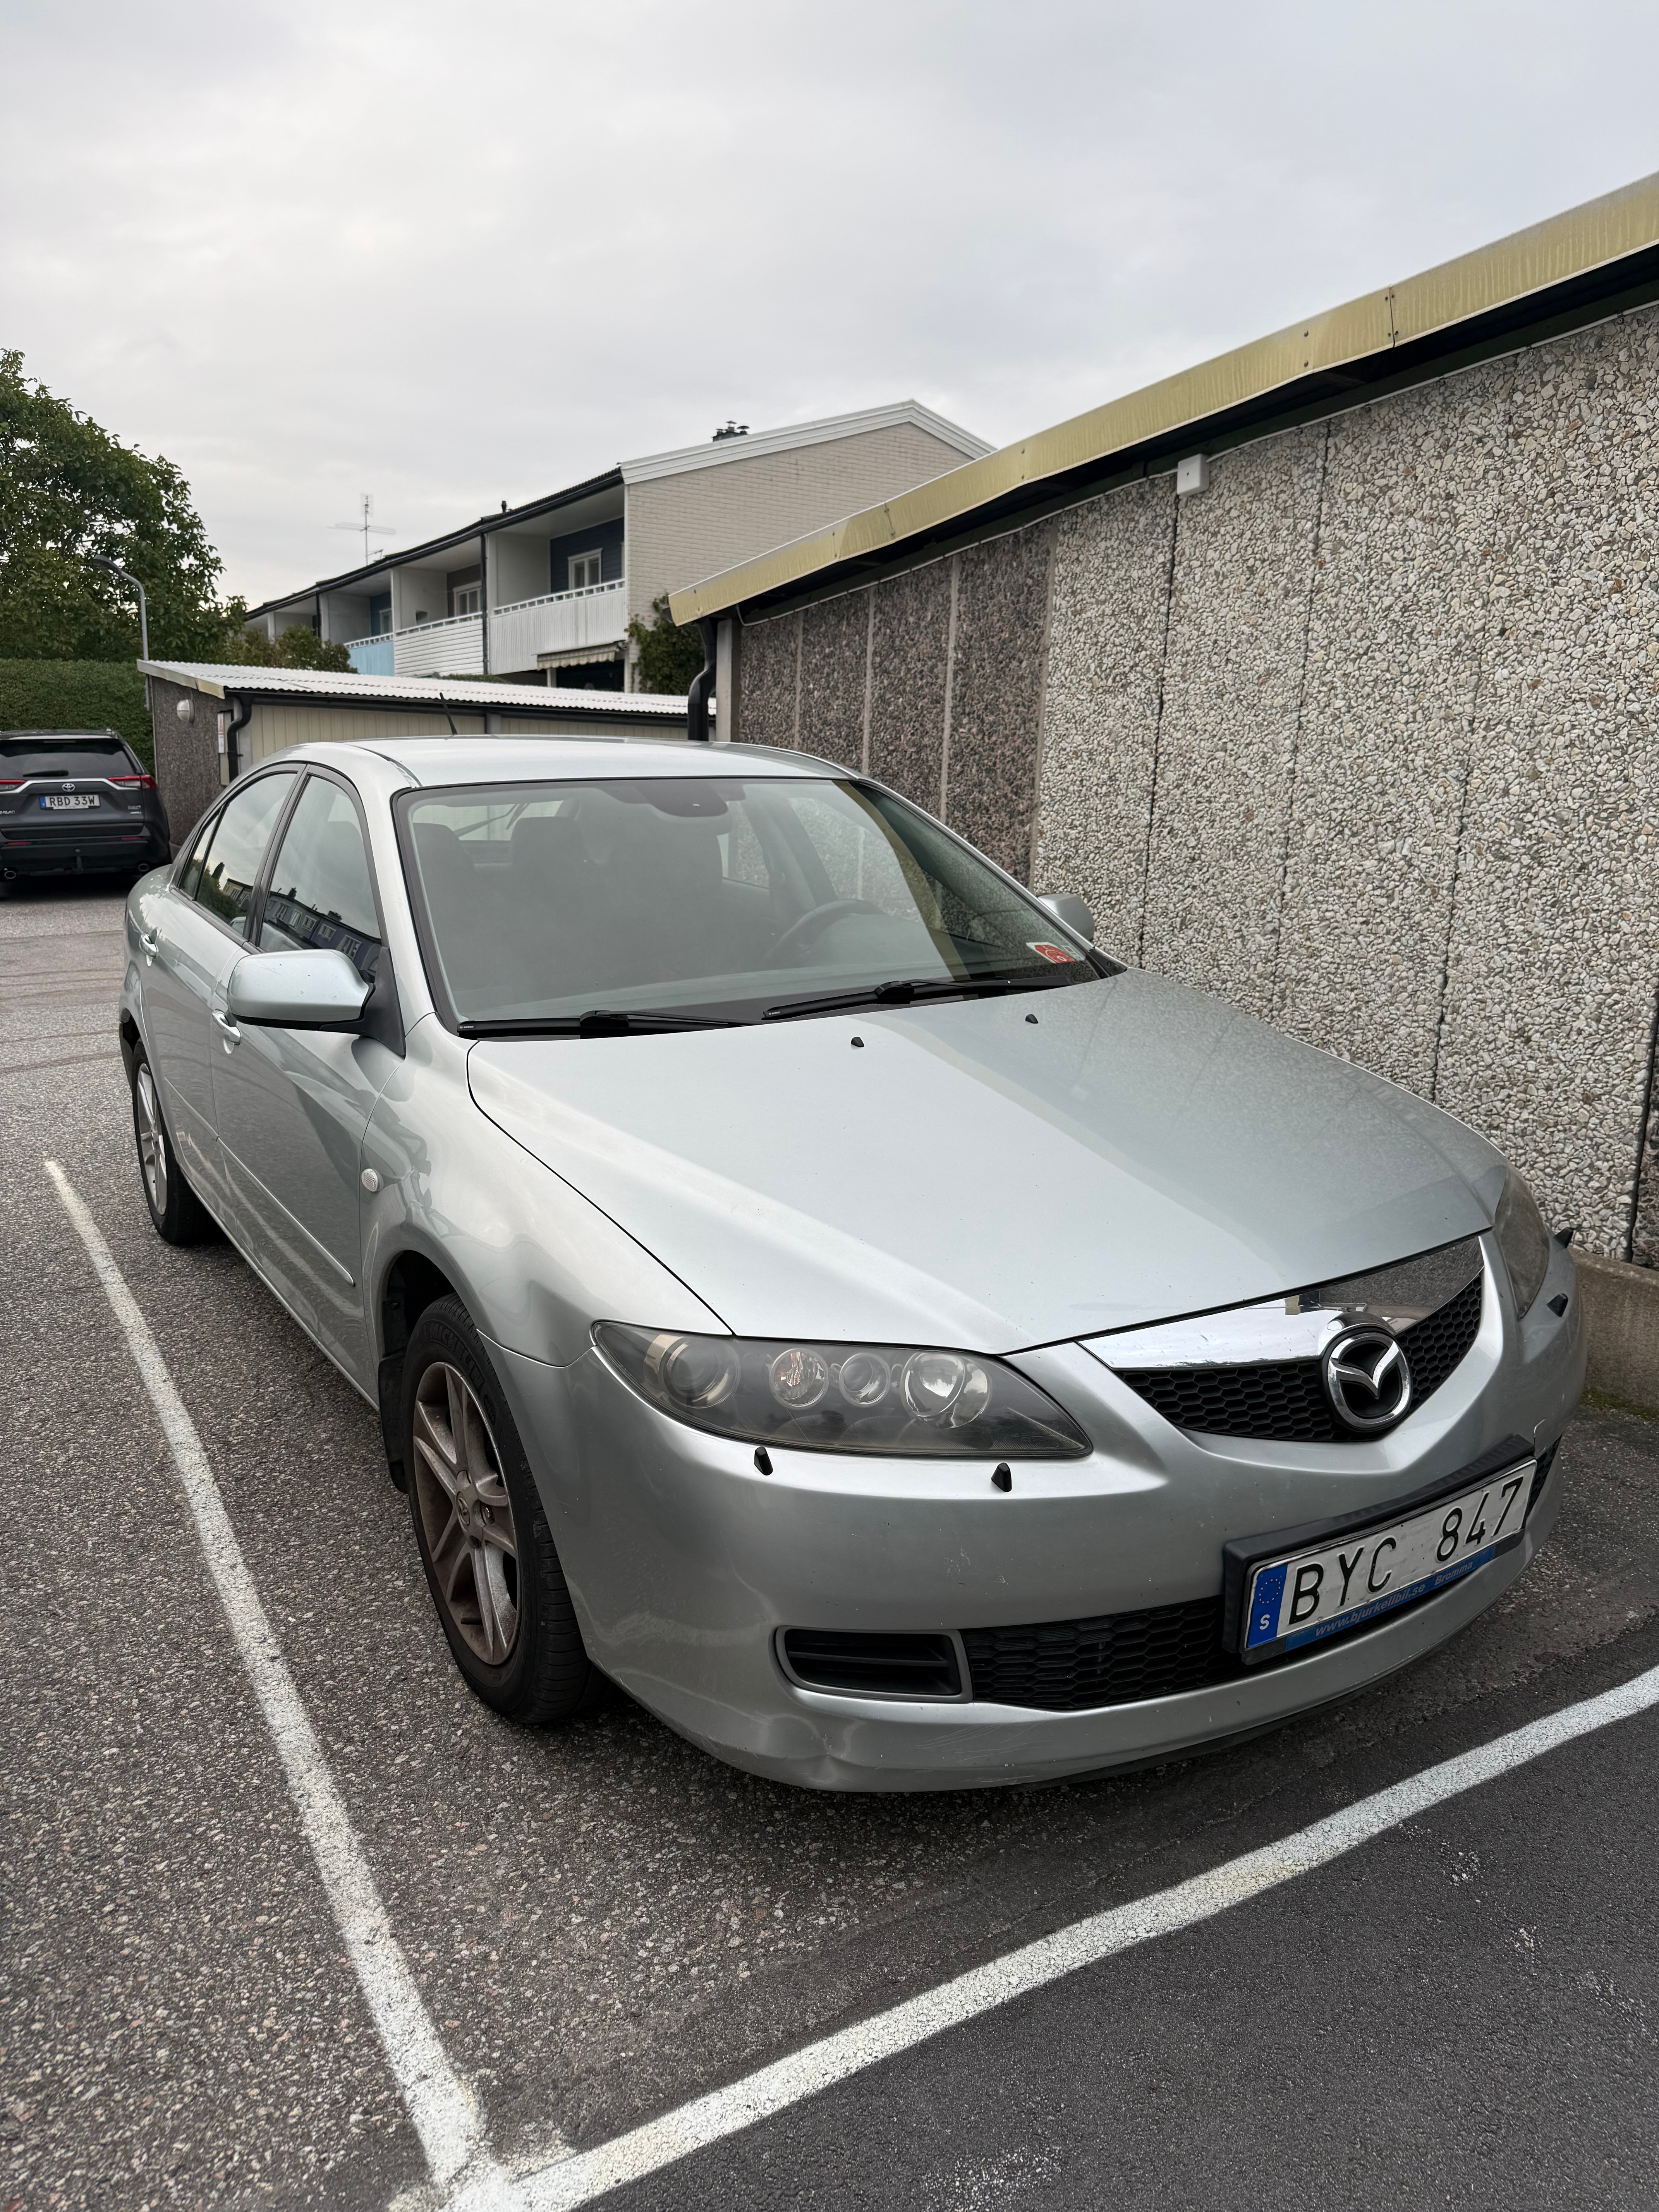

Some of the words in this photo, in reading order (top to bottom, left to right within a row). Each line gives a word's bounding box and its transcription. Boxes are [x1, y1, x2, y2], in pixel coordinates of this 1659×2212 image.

[50, 797, 70, 806] RBD
[74, 796, 94, 805] 33W
[430, 1323, 484, 1391] MICHELIN
[1288, 1537, 1396, 1625] BYC
[1436, 1476, 1524, 1563] 847
[1259, 1614, 1270, 1630] S
[1316, 1583, 1425, 1637] www.bjurkellbil.se
[1434, 1561, 1473, 1586] Bromma
